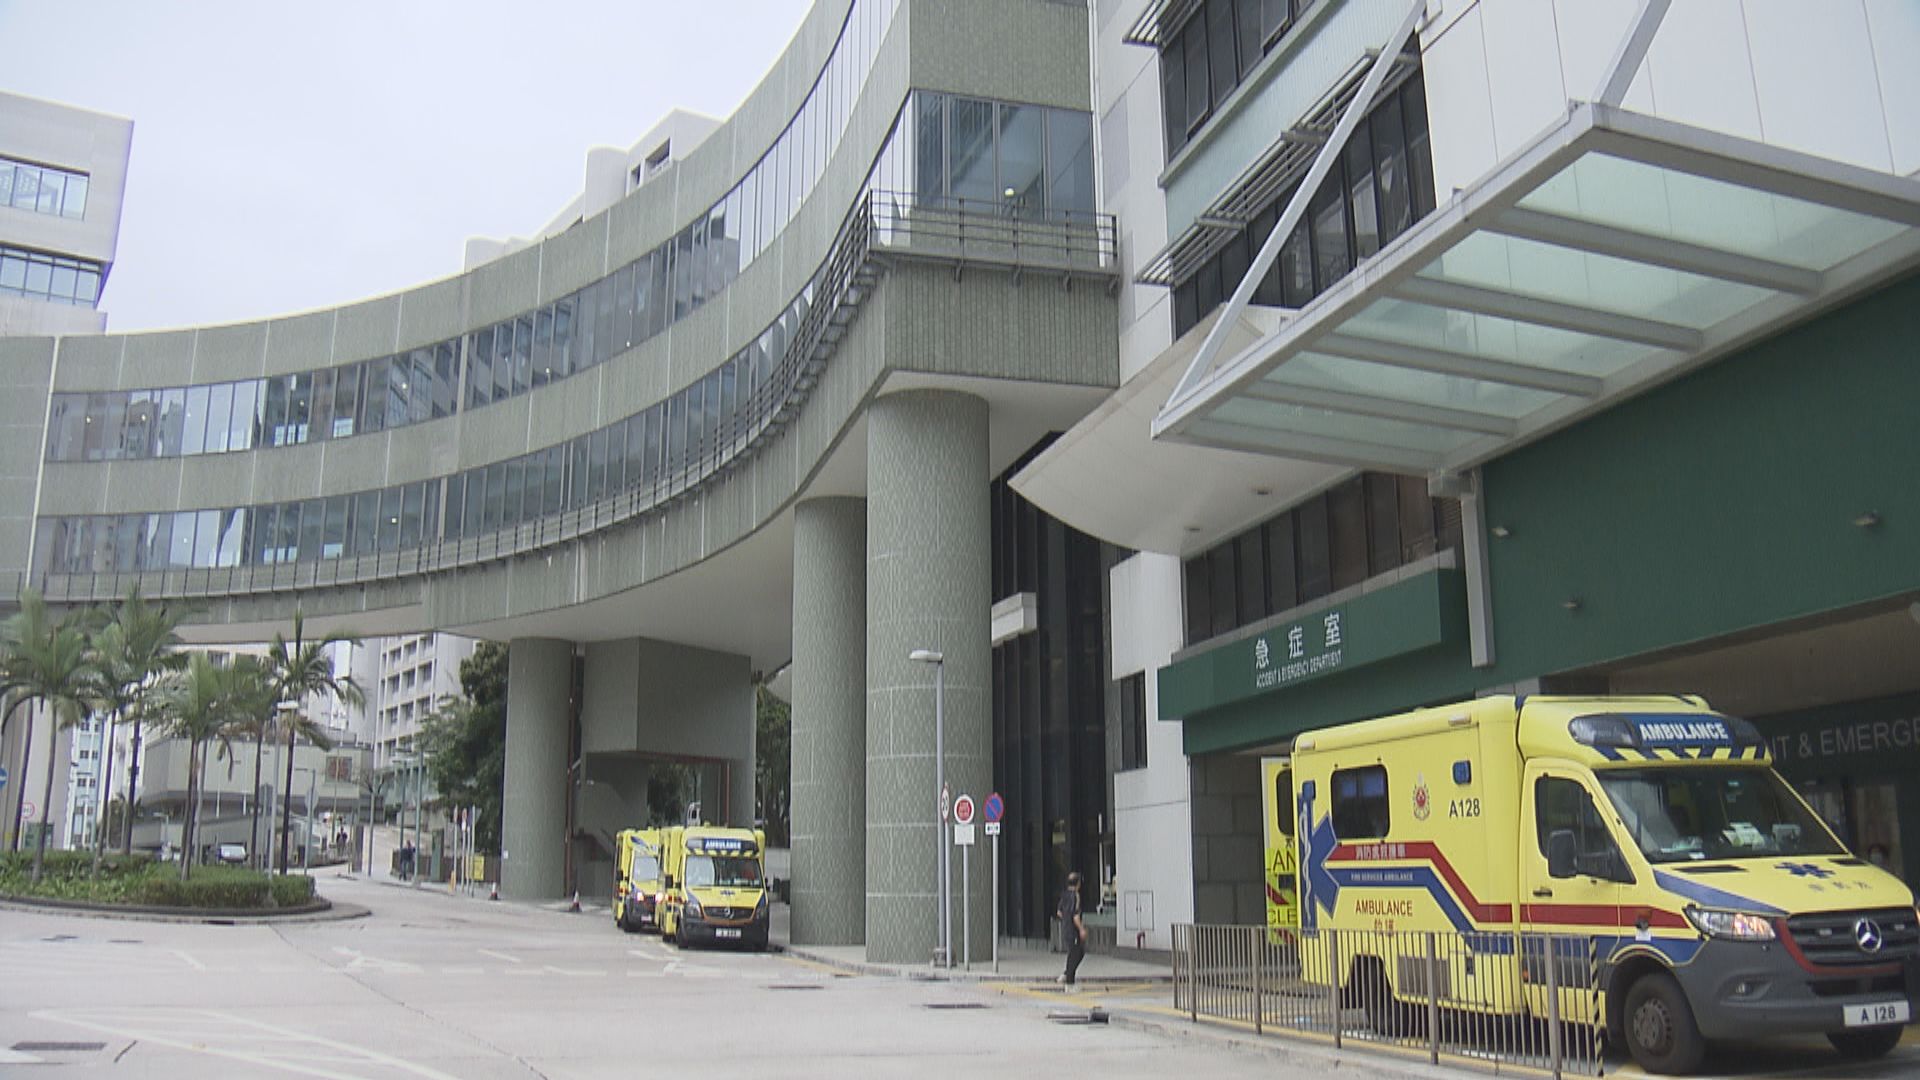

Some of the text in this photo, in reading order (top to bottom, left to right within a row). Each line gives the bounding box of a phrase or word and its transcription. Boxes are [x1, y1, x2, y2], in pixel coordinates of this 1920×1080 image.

[1256, 612, 1341, 669] 急症室
[1639, 722, 1729, 741] AMBULANCE
[1799, 732, 1813, 758] &
[1449, 797, 1480, 817] A128
[1355, 899, 1413, 917] AMBULANCE
[1861, 1005, 1897, 1022] A 128
